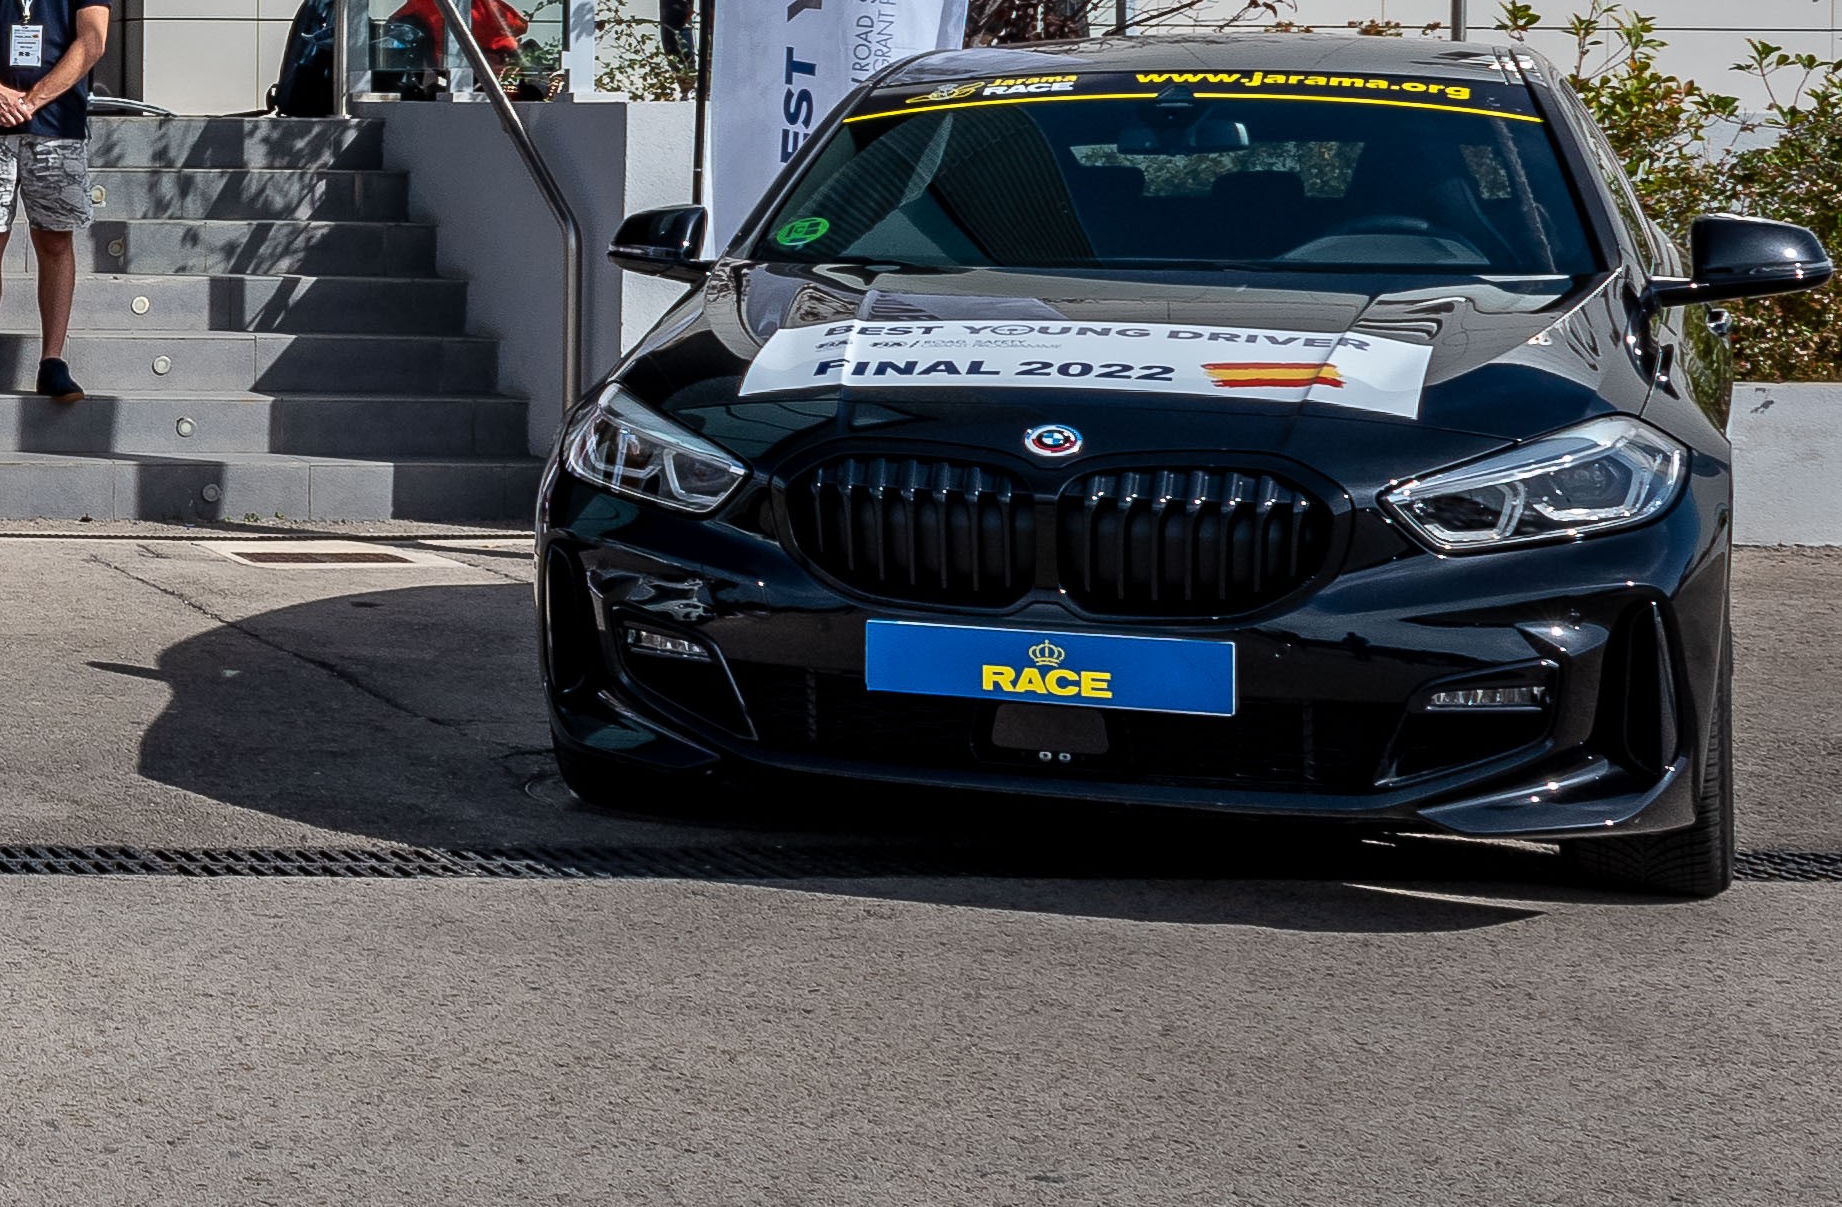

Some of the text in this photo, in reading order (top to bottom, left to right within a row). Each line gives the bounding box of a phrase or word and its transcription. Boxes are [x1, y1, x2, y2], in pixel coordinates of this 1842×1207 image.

[853, 14, 875, 73] ROAD
[872, 9, 896, 73] GRANT
[981, 81, 1076, 96] RACE
[986, 74, 1079, 88] Jarama
[1135, 71, 1472, 100] www.jarama.org
[779, 46, 817, 164] EST
[824, 324, 1372, 352] BEST YOUNG DRIVER
[813, 358, 1176, 382] FINAL 2022
[981, 664, 1113, 699] RACE
